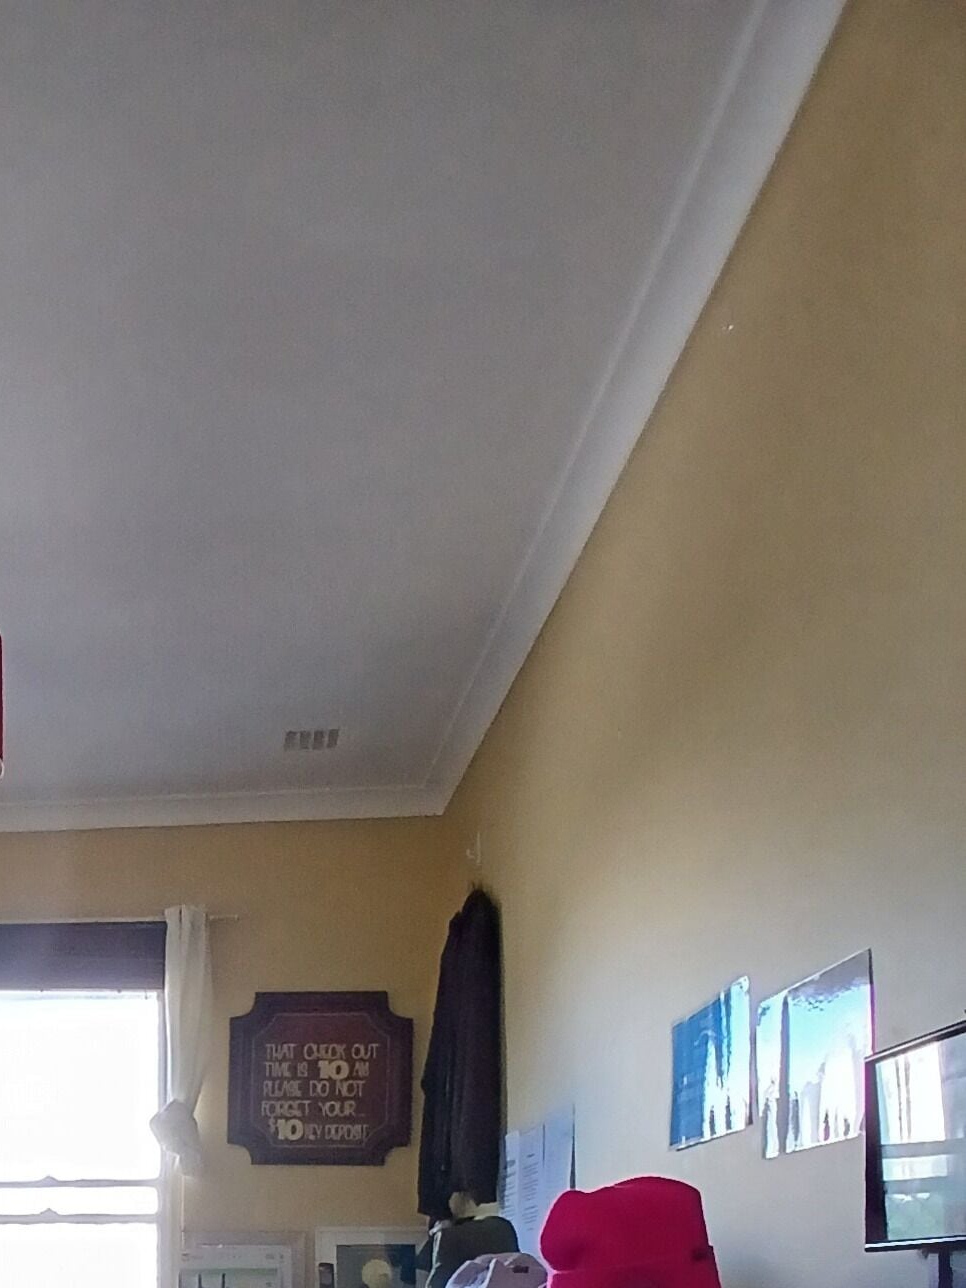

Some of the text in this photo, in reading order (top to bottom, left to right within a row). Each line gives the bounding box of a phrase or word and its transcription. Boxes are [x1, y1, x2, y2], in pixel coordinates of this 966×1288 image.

[266, 1044, 379, 1059] THAT CHECK OUT
[265, 1060, 370, 1080] TIME IS 10 AM
[263, 1081, 366, 1097] PLEASE DO NOT
[262, 1100, 311, 1117] FORGET
[268, 1117, 304, 1141] $10
[325, 1124, 369, 1141] DEPOSIT
